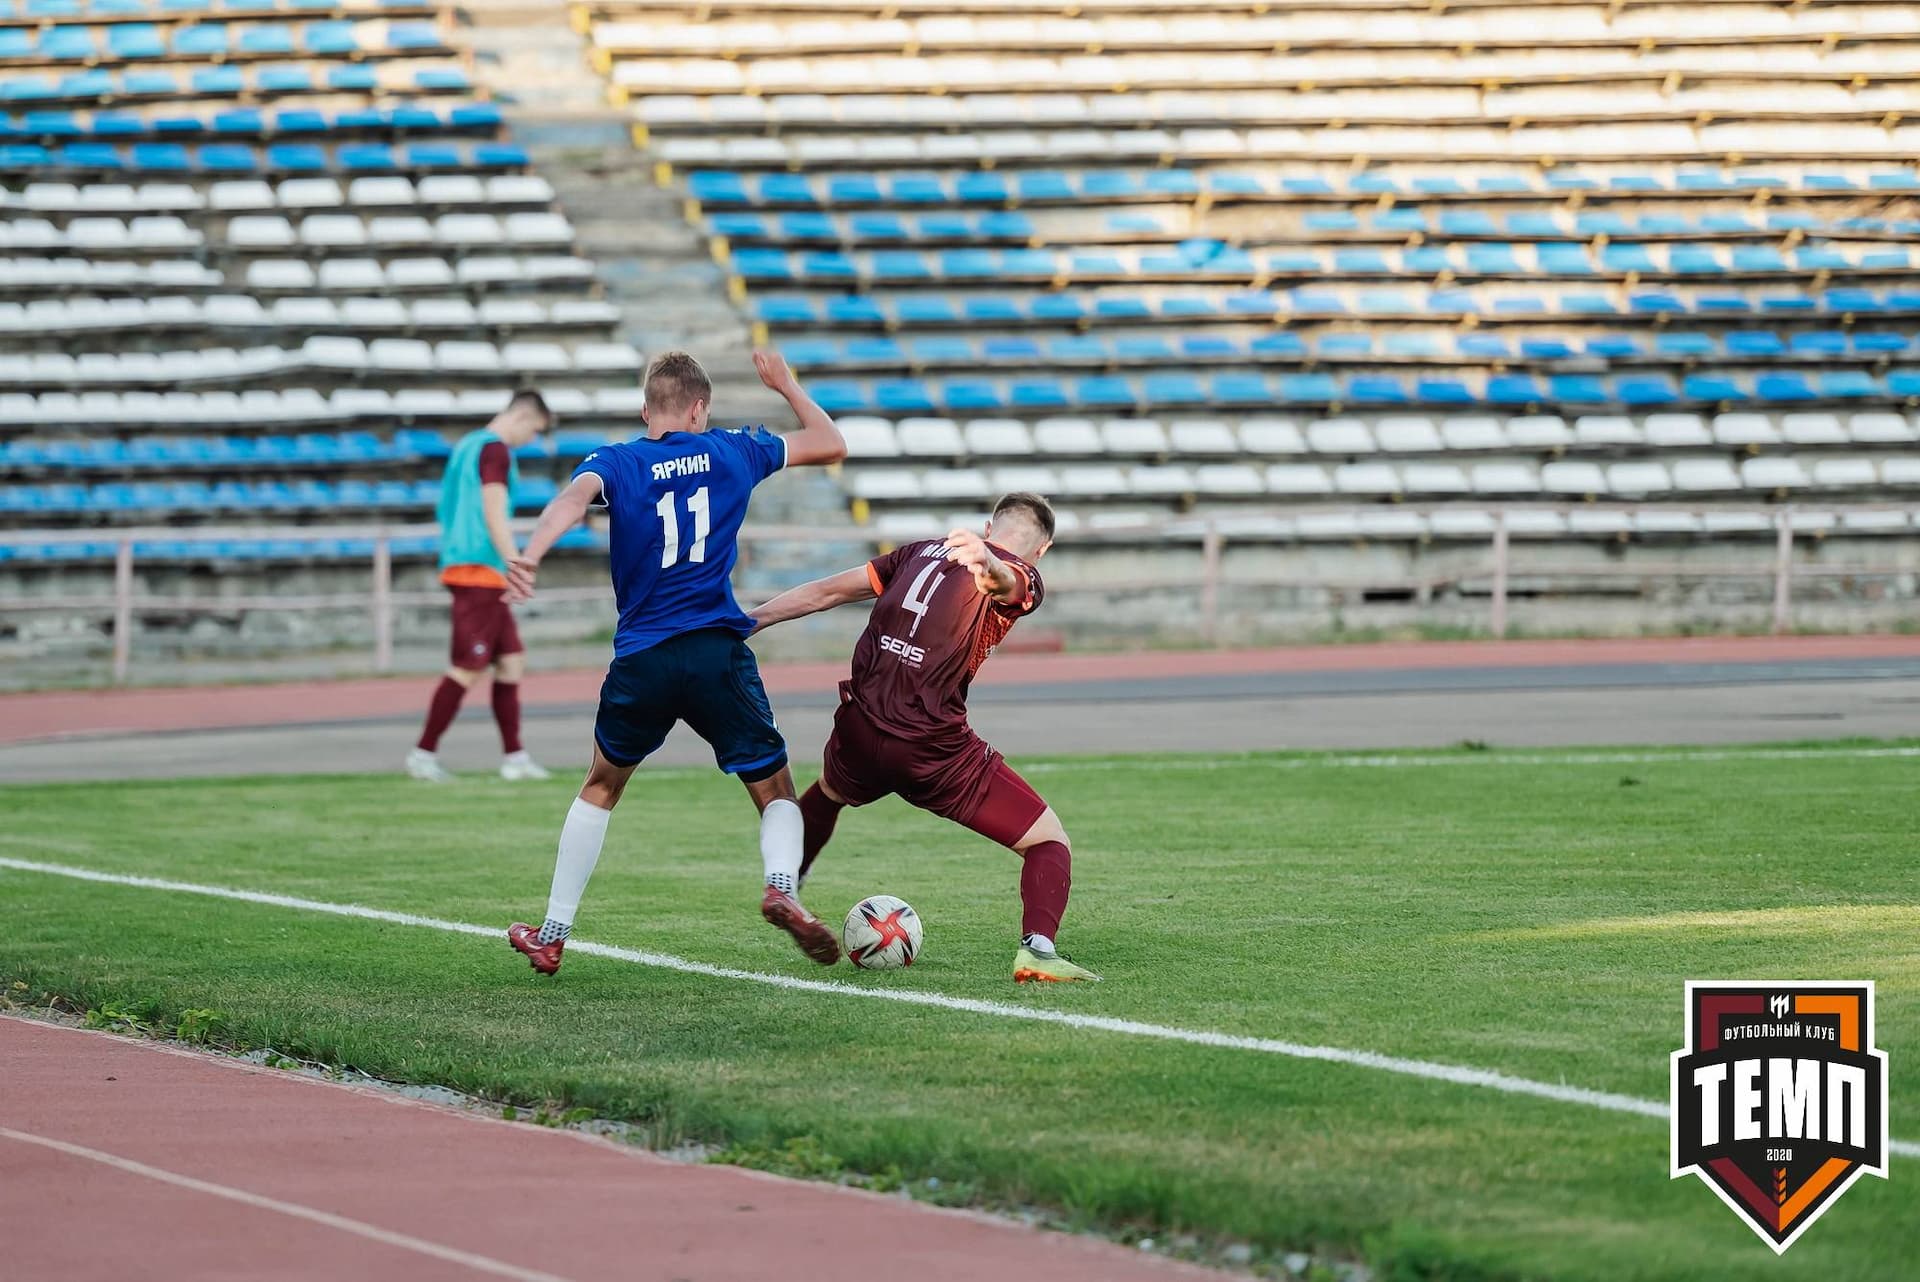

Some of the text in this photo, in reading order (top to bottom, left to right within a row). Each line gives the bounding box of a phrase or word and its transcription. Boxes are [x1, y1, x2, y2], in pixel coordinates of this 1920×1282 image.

[651, 453, 711, 480] ЯРКИН
[656, 486, 710, 568] 11
[901, 560, 946, 638] 4
